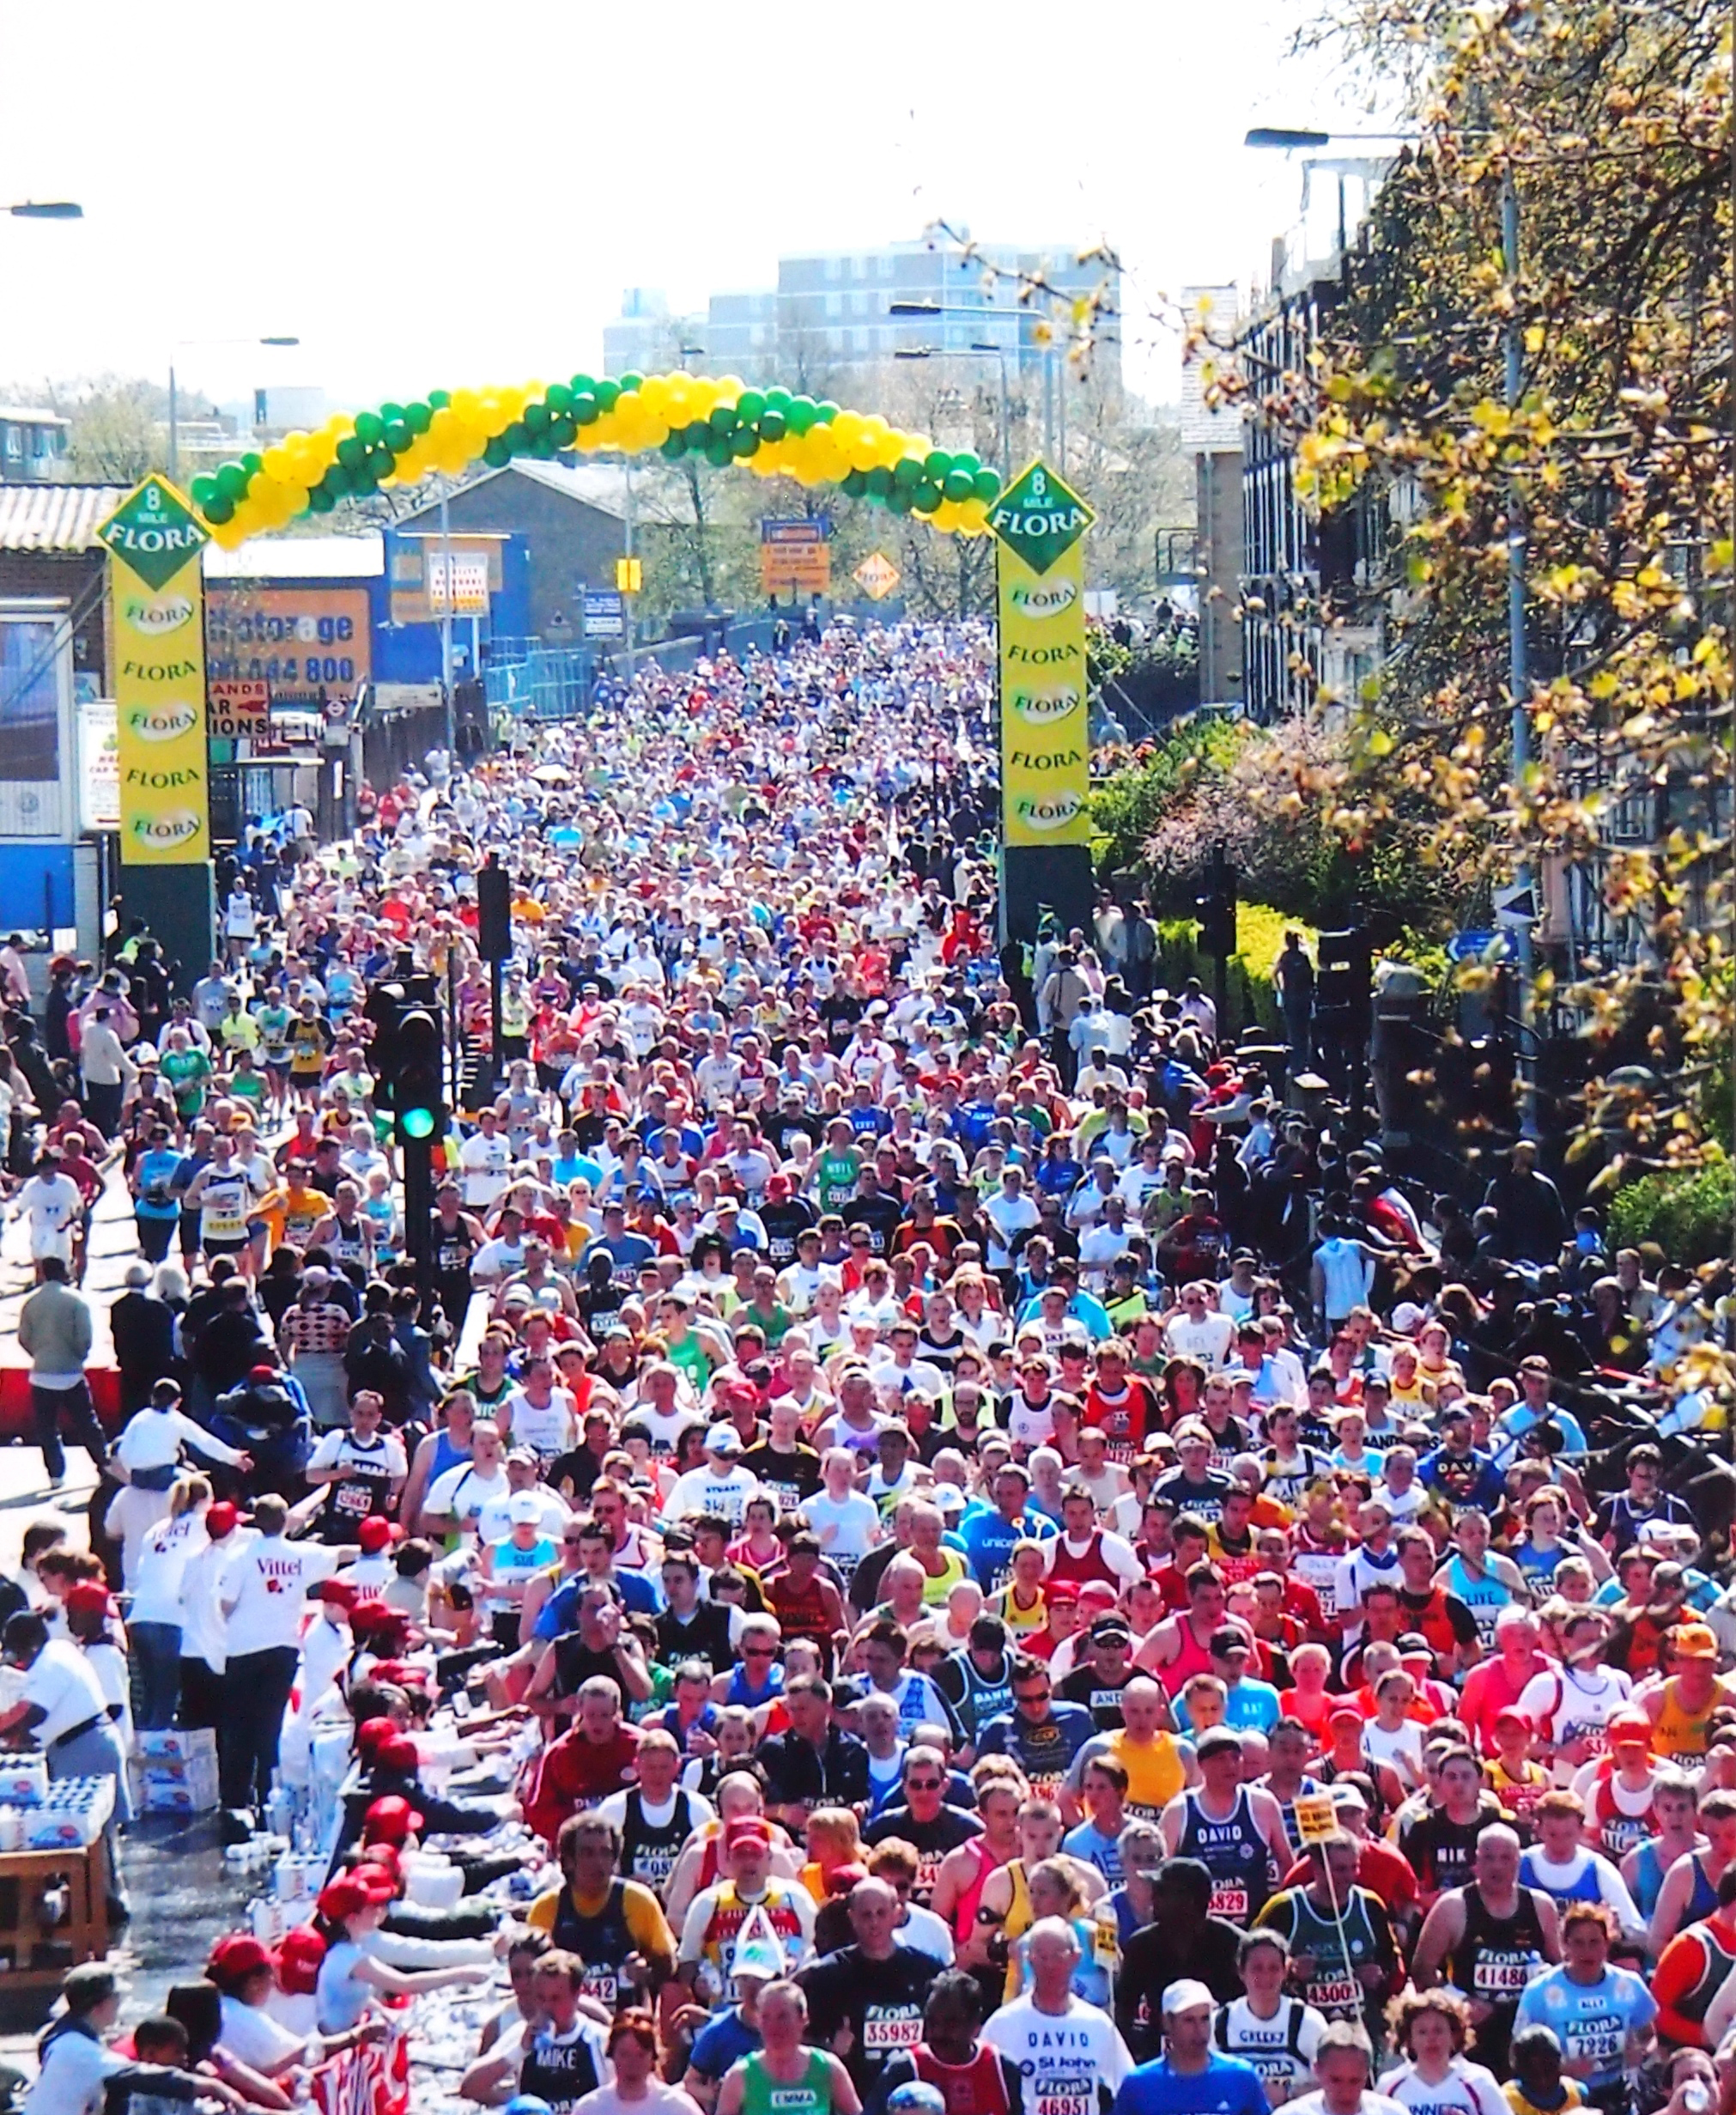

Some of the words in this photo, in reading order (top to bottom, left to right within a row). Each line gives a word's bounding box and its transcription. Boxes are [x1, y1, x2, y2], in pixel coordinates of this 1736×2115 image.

[1032, 473, 1045, 495] 8
[146, 486, 161, 511] 8
[992, 506, 1089, 537] FLORA
[105, 521, 207, 553] FLORA
[1011, 585, 1076, 606] FLORA
[126, 604, 194, 625] FLORA
[1008, 643, 1079, 665] FLORA
[124, 660, 197, 682] FLORA
[306, 657, 354, 684] 800
[1014, 691, 1079, 714] FLORA
[129, 709, 197, 732] FLORA
[1010, 750, 1082, 771] FLORA
[125, 768, 200, 789] FLORA
[1017, 797, 1082, 818] FLORA
[132, 817, 200, 838] FLORA
[257, 1557, 301, 1577] Vittel
[1198, 1825, 1242, 1844] DAVID
[1477, 1948, 1529, 1966] FLORA
[866, 2003, 921, 2021] FLORA
[868, 2022, 920, 2044] 35982
[1568, 2016, 1620, 2034] FLORA
[1028, 2031, 1089, 2048] DAVID
[1036, 2079, 1090, 2096] FLORA
[1038, 2096, 1090, 2115] 46951
